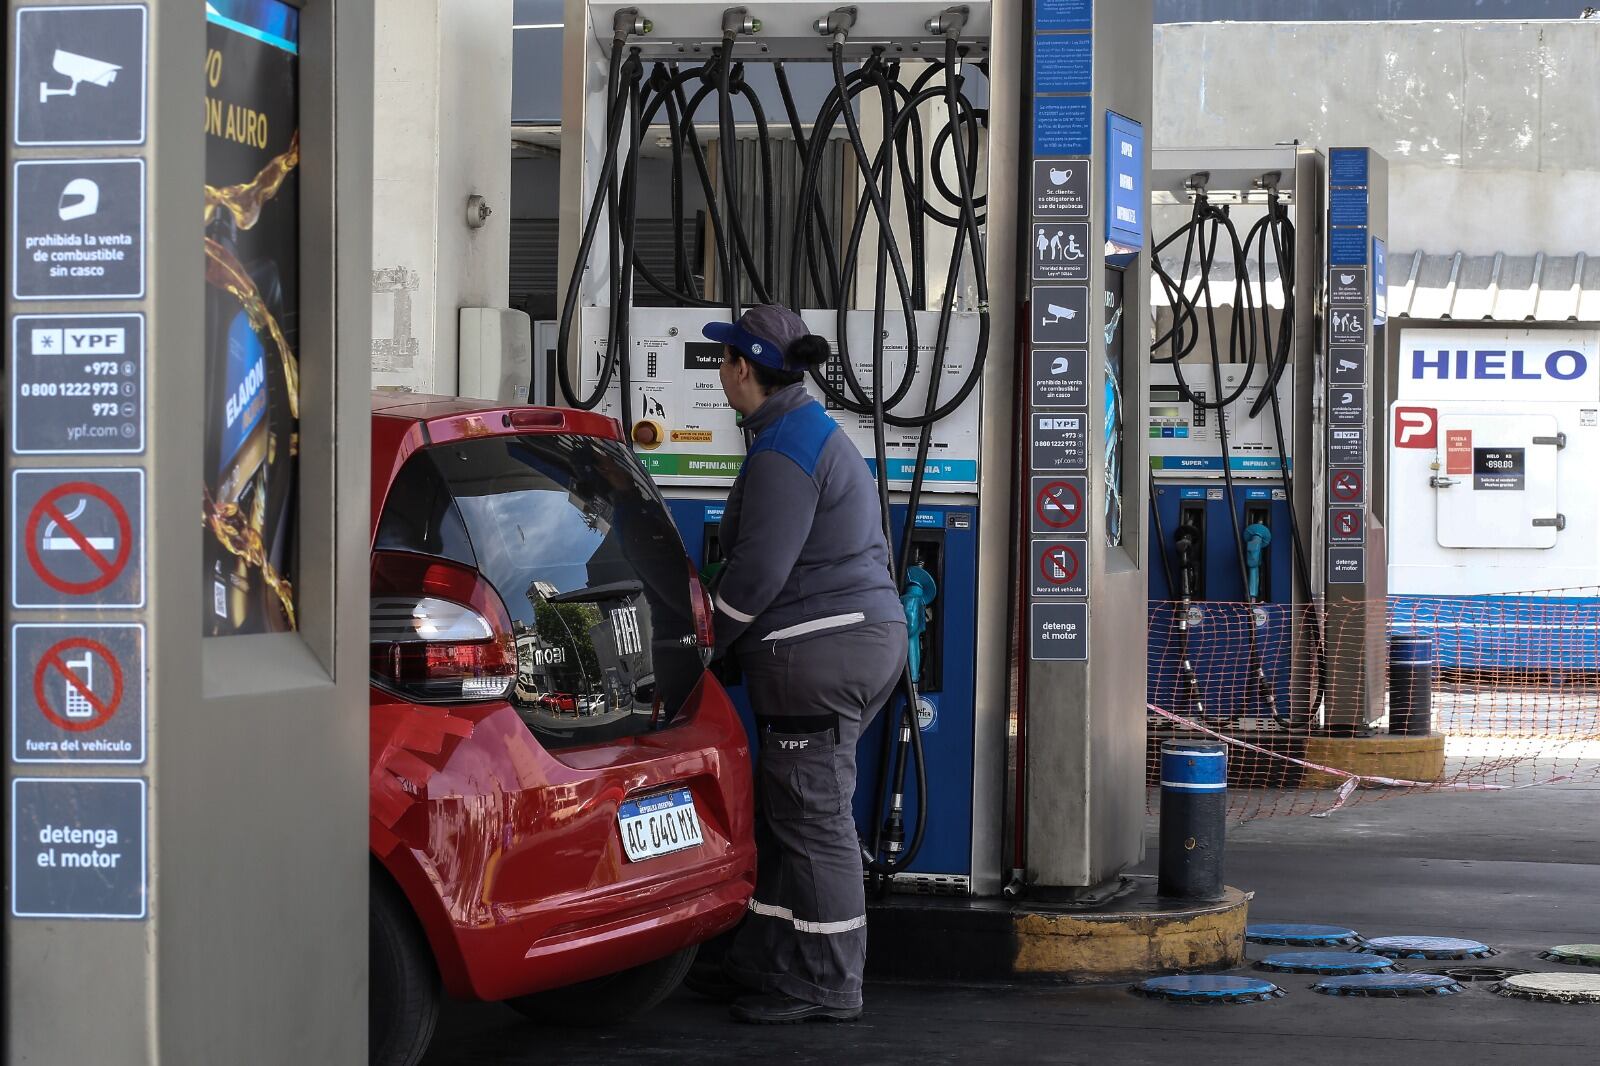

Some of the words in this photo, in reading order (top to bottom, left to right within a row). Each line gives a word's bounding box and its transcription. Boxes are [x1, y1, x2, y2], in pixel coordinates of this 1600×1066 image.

[225, 104, 268, 149] AURO
[26, 234, 82, 248] prohibida
[85, 233, 96, 246] la
[99, 235, 132, 246] venta
[33, 250, 48, 262] de
[51, 248, 124, 262] combustible
[50, 264, 68, 276] sin
[70, 266, 104, 277] casco
[72, 334, 118, 348] YPF
[1412, 350, 1587, 380] HIELO
[226, 357, 264, 428] ELAION
[92, 403, 118, 416] 973
[67, 424, 118, 440] ypf.com
[610, 606, 642, 656] FIAT
[1042, 622, 1076, 631] detenga
[26, 740, 58, 752] fuera
[60, 740, 79, 751] del
[82, 740, 132, 752] vehículo
[779, 740, 808, 749] YPF
[39, 825, 118, 847] detenga
[627, 820, 647, 854] AC
[649, 812, 678, 848] 040
[677, 807, 698, 841] MX
[37, 849, 56, 867] el
[61, 852, 120, 867] motor
